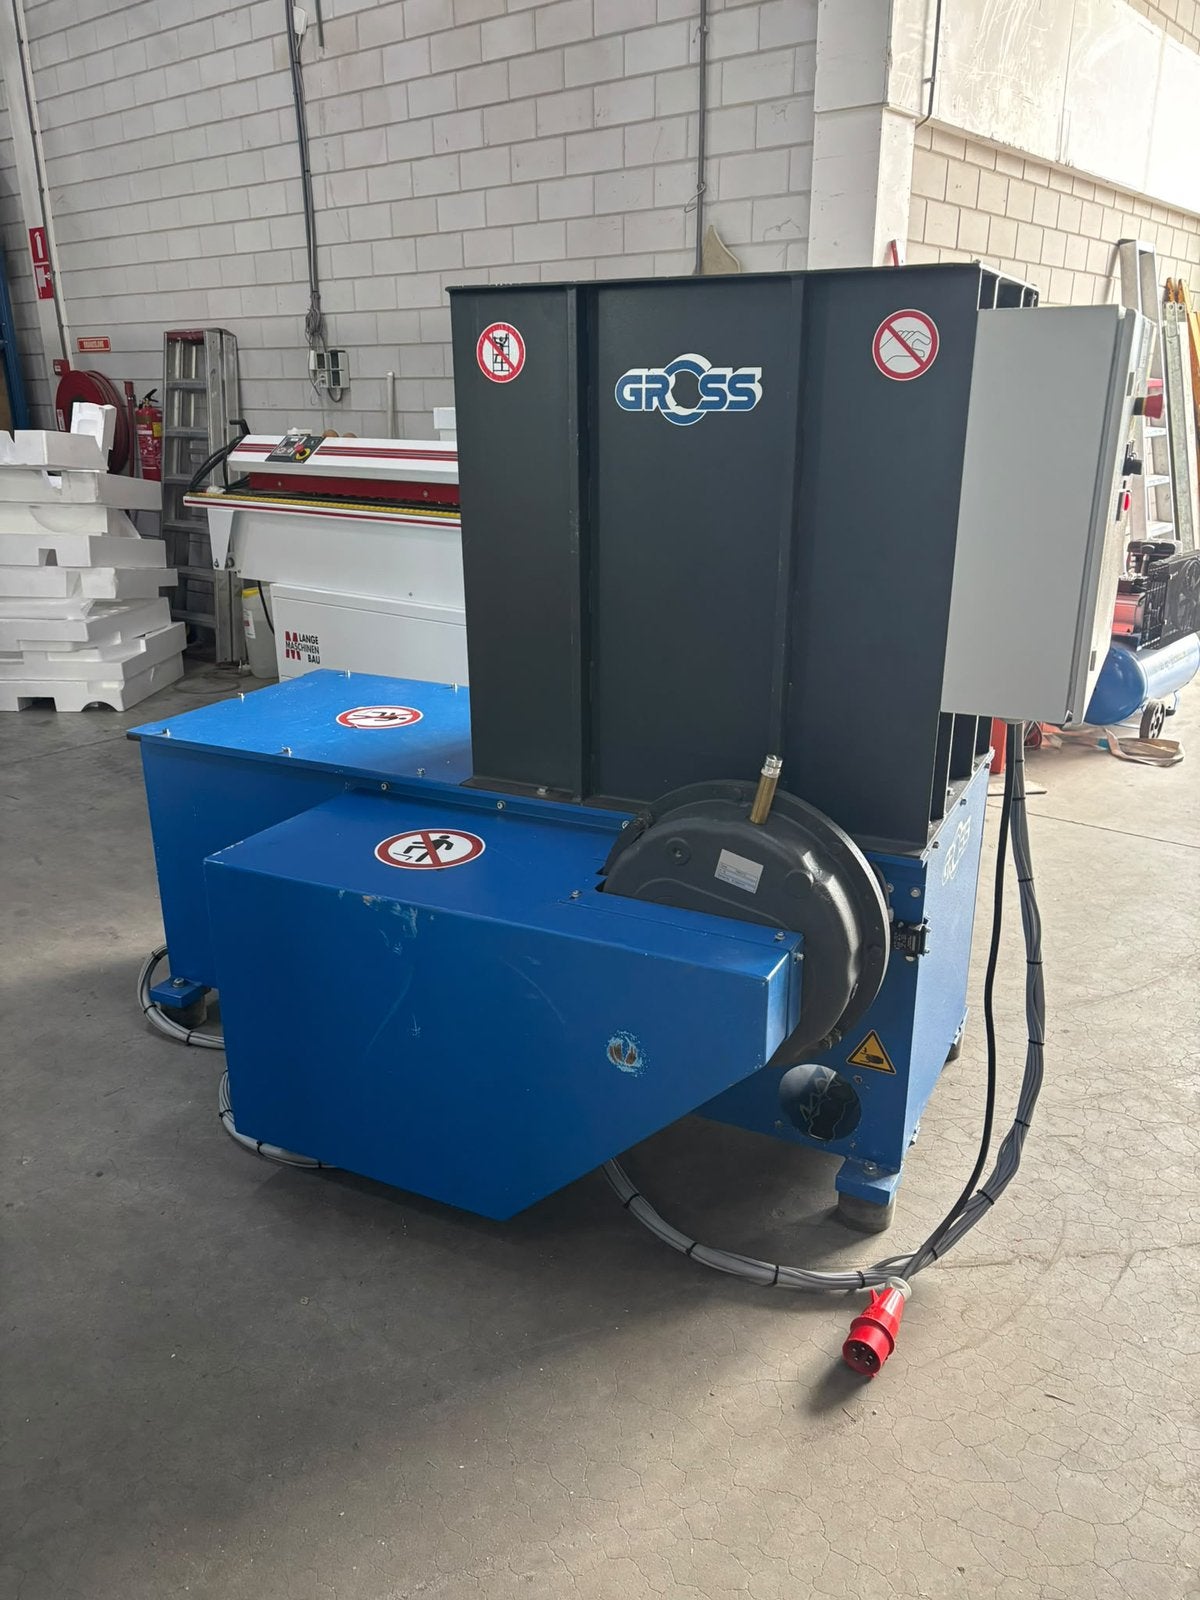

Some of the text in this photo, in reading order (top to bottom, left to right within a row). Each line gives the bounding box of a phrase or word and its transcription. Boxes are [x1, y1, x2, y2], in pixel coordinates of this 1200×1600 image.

[615, 353, 763, 426] GROSS
[299, 633, 318, 645] LANGE
[285, 641, 320, 655] MASCHINEN
[308, 654, 320, 665] BAU
